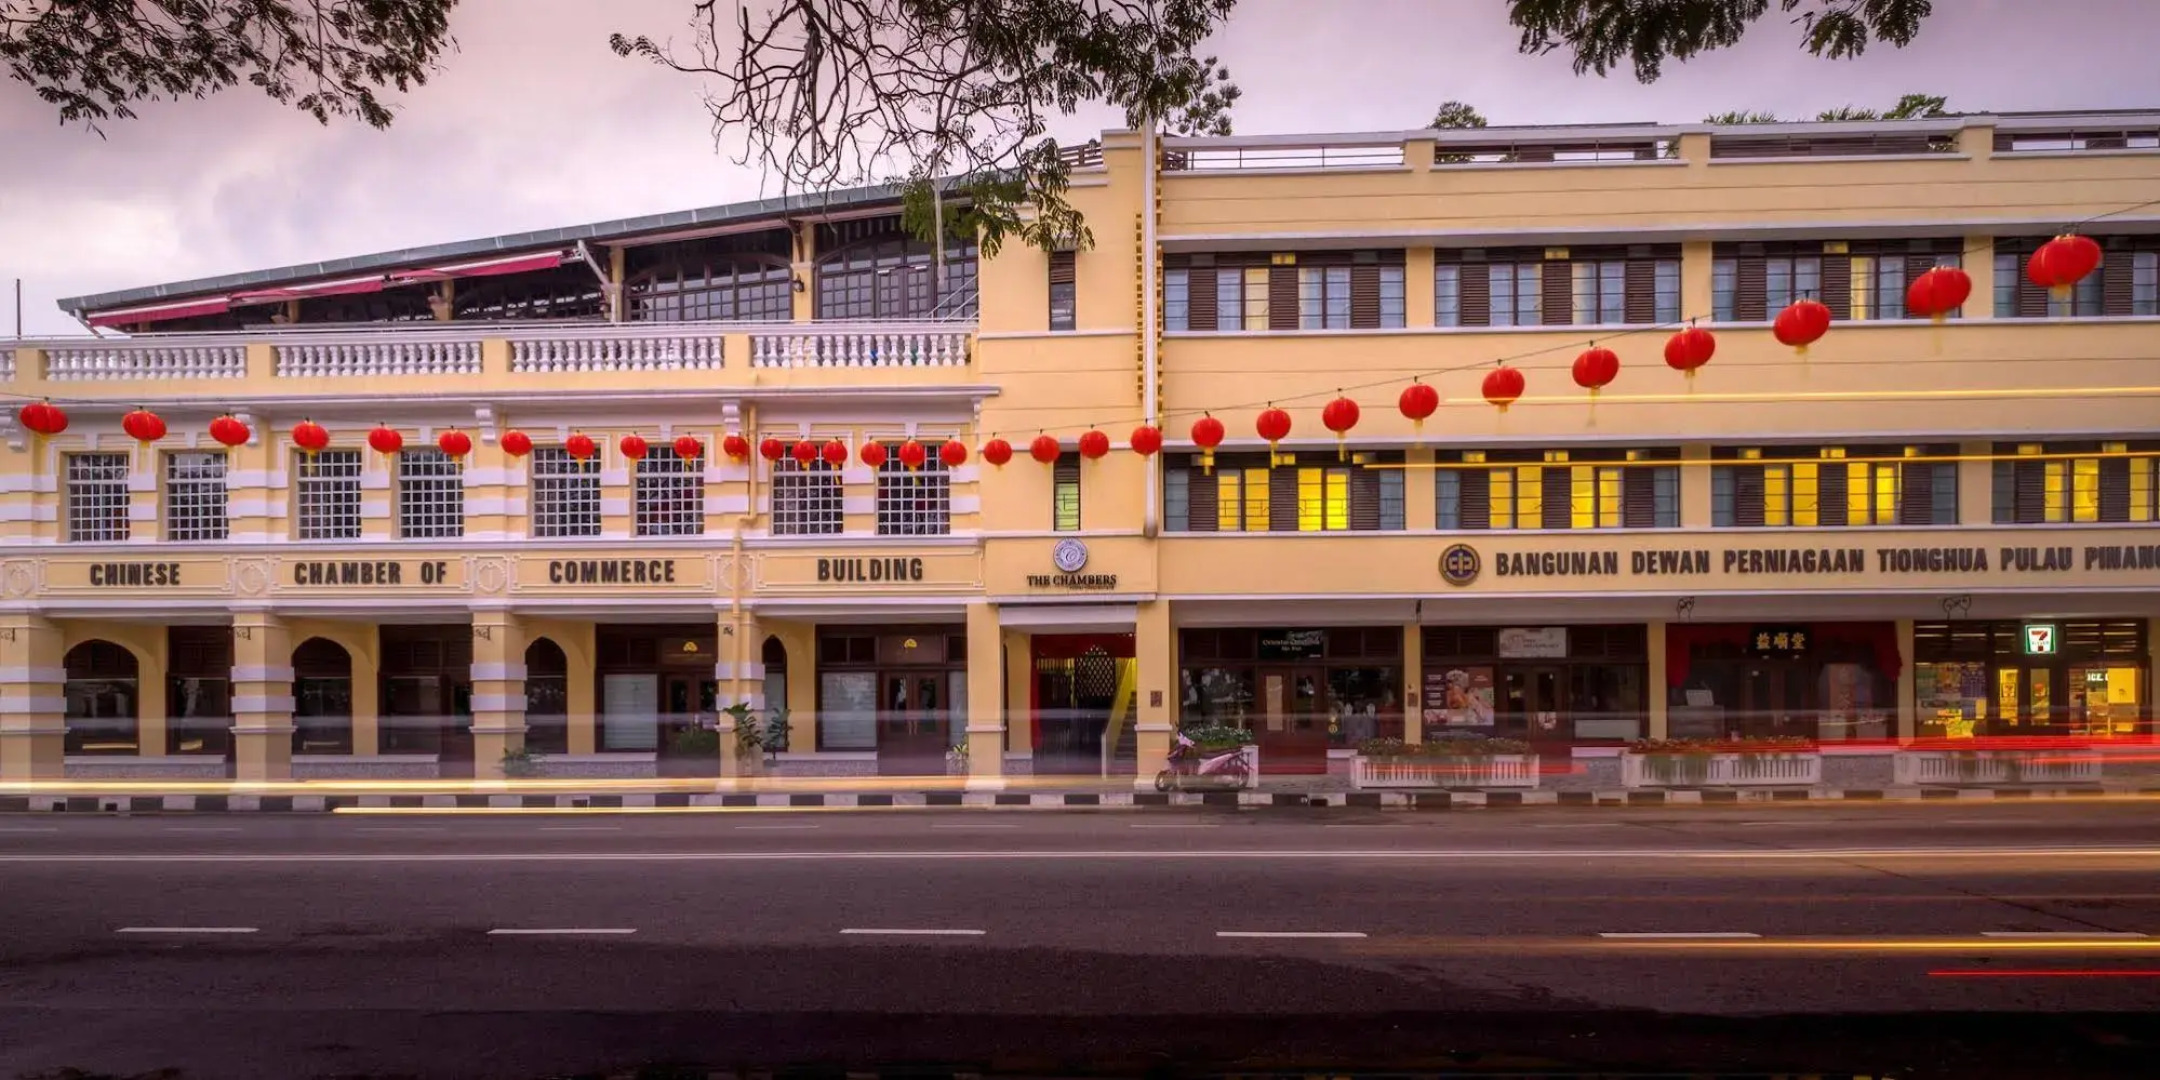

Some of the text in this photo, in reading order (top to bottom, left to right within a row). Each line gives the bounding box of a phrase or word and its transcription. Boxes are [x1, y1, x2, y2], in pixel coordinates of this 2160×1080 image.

[90, 557, 923, 586] CHINESE CHAMBER OF COMMERCE BUILDING
[1495, 551, 1618, 577] BANGUNAN
[1631, 550, 1710, 575] DEWAN
[1723, 548, 1865, 574] PERNIAGAAN
[1876, 547, 1989, 573] TIONGHUA
[2000, 546, 2073, 572] PULAU
[1027, 574, 1117, 586] THE CHAMBERS
[2031, 630, 2048, 652] 7
